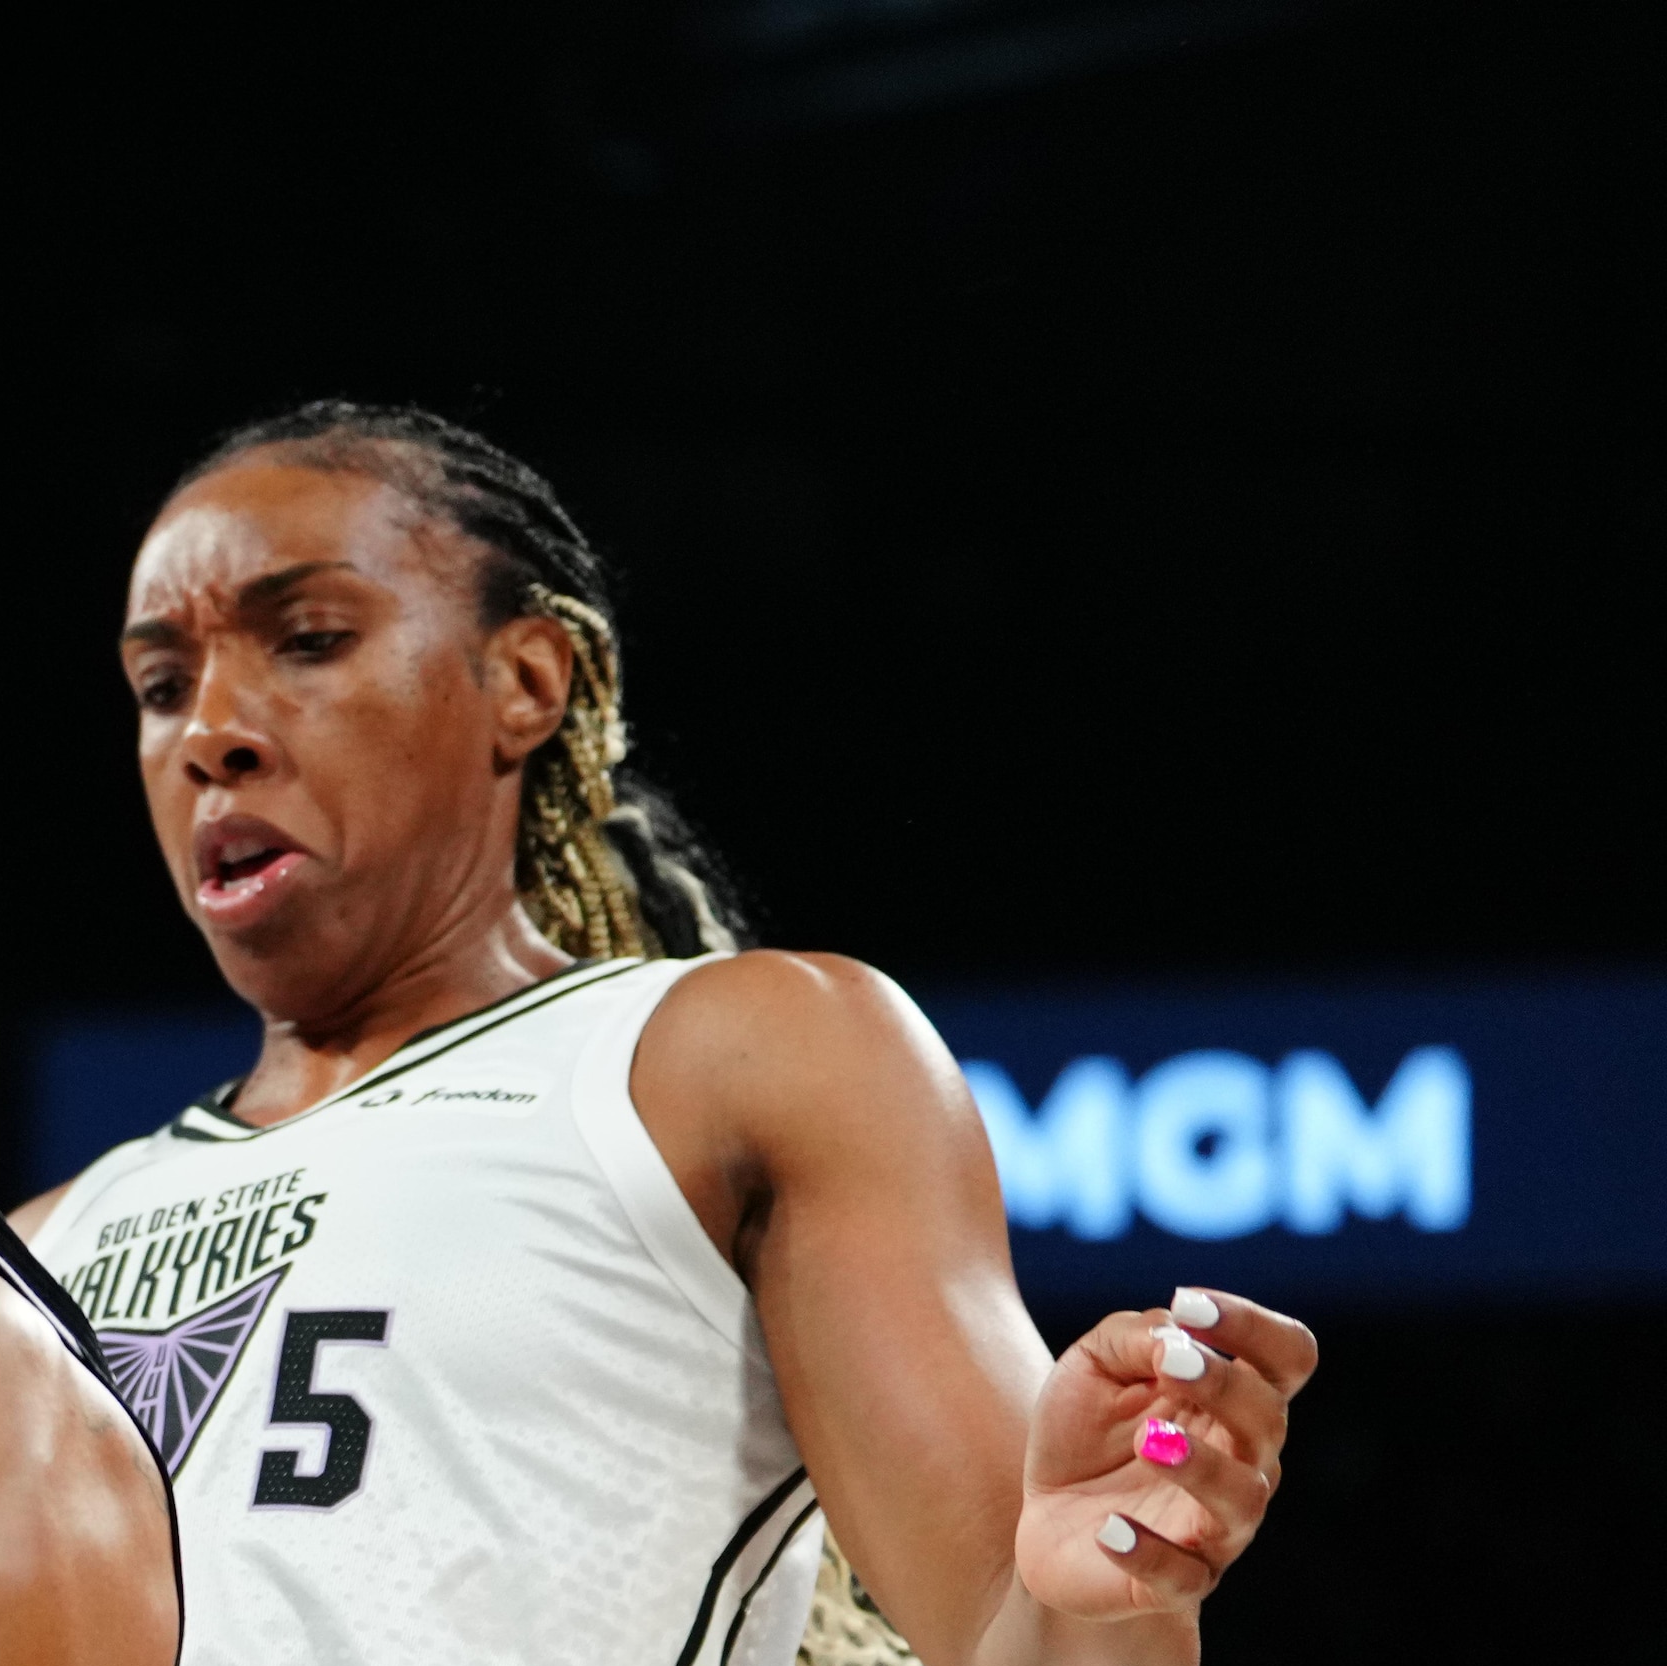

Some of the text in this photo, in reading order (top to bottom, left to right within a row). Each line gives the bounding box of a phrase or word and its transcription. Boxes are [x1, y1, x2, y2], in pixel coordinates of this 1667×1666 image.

[61, 1193, 327, 1320] VALKYRIES
[97, 1167, 307, 1250] GOLDEN STATE
[248, 1308, 395, 1513] 5
